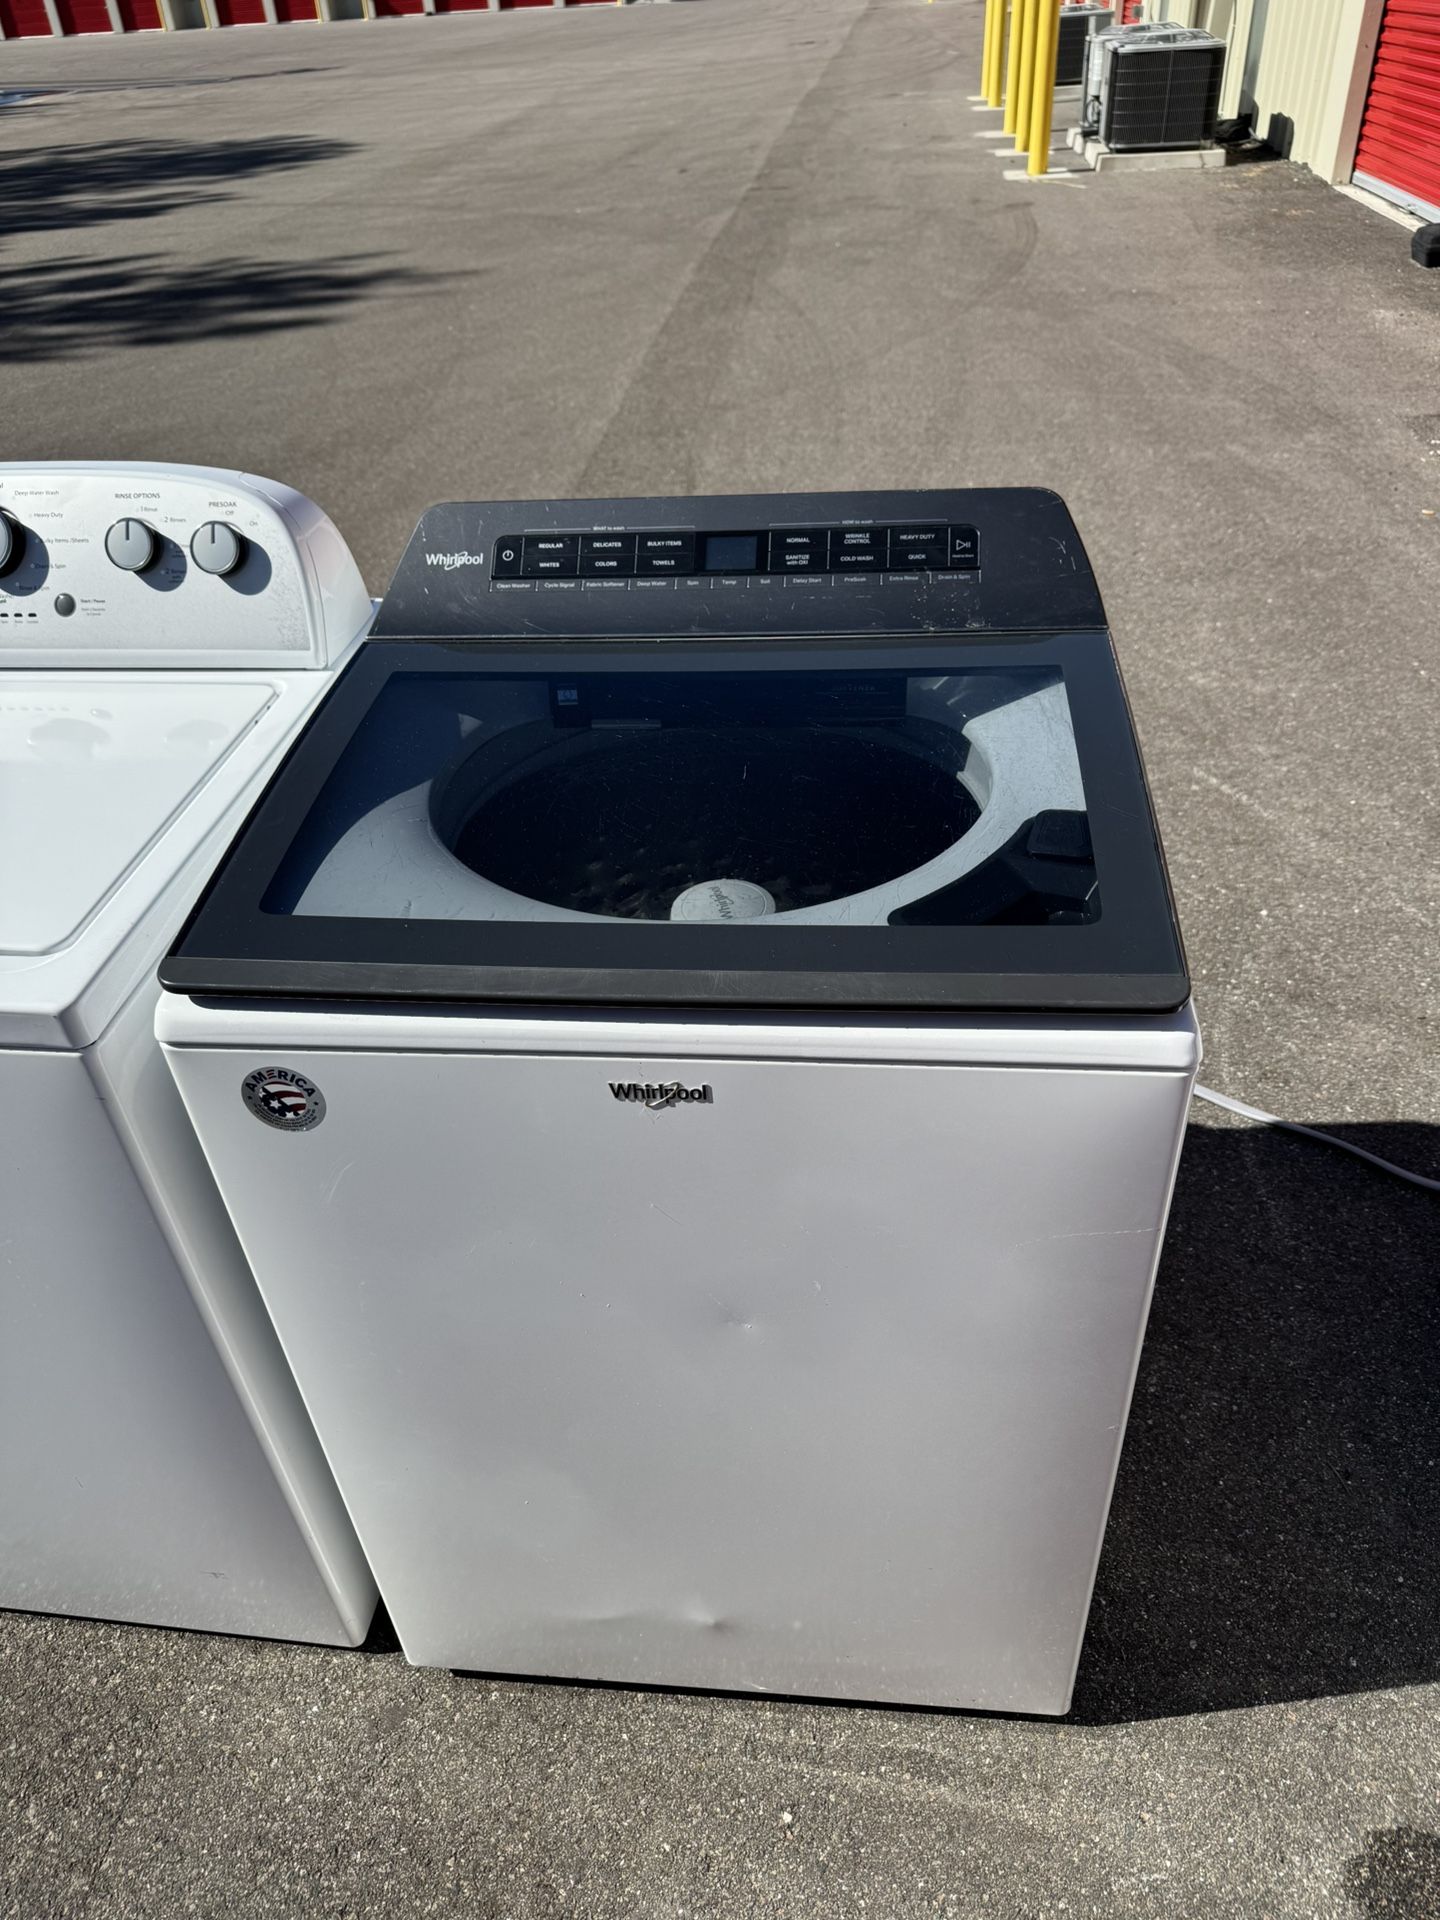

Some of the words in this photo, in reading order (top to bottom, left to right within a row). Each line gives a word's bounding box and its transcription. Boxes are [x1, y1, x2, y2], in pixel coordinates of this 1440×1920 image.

[51, 511, 64, 519] Duty
[425, 551, 484, 570] Whirlpool
[245, 1068, 316, 1097] AMERICA
[608, 1081, 713, 1108] Whirlpool
